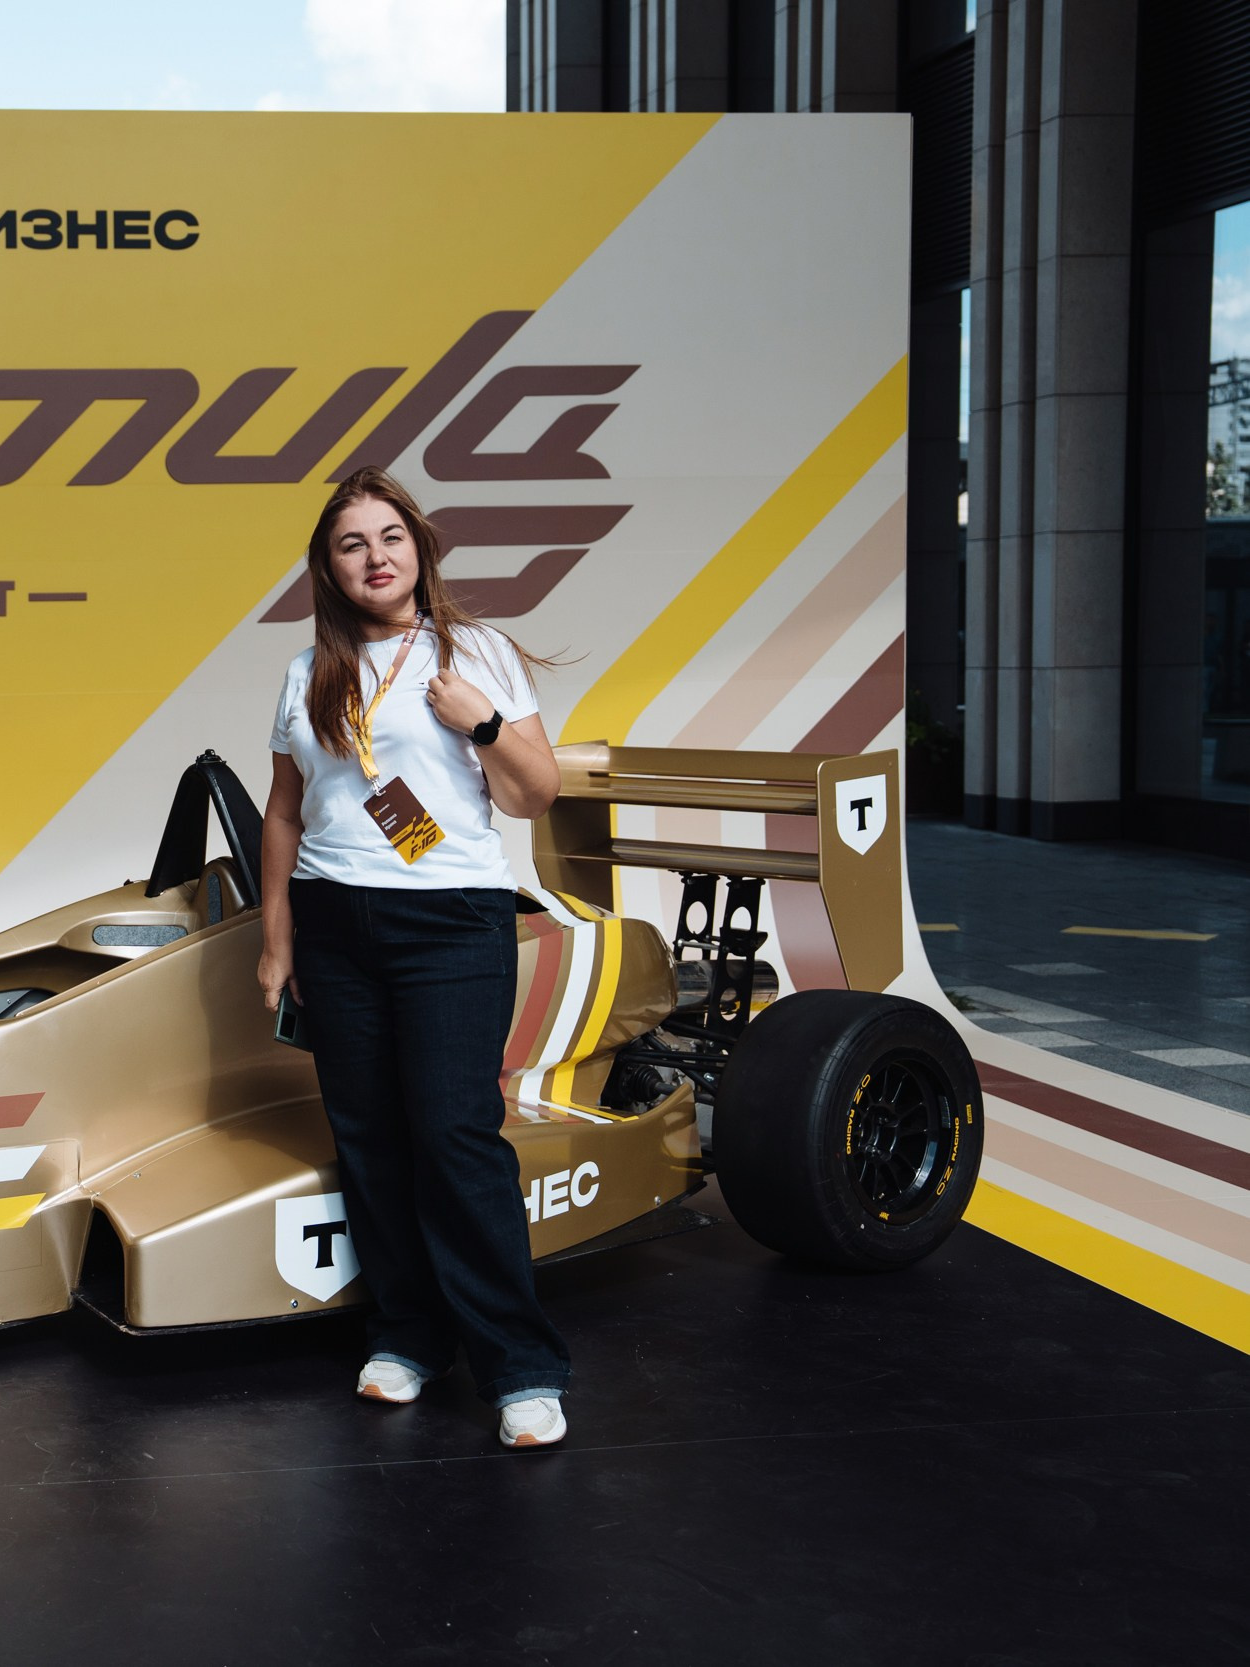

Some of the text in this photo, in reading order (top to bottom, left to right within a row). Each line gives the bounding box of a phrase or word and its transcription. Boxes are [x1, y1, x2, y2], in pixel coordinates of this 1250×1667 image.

[846, 1108, 856, 1155] RACING
[951, 1117, 960, 1162] RACING
[523, 1160, 600, 1224] НЕС
